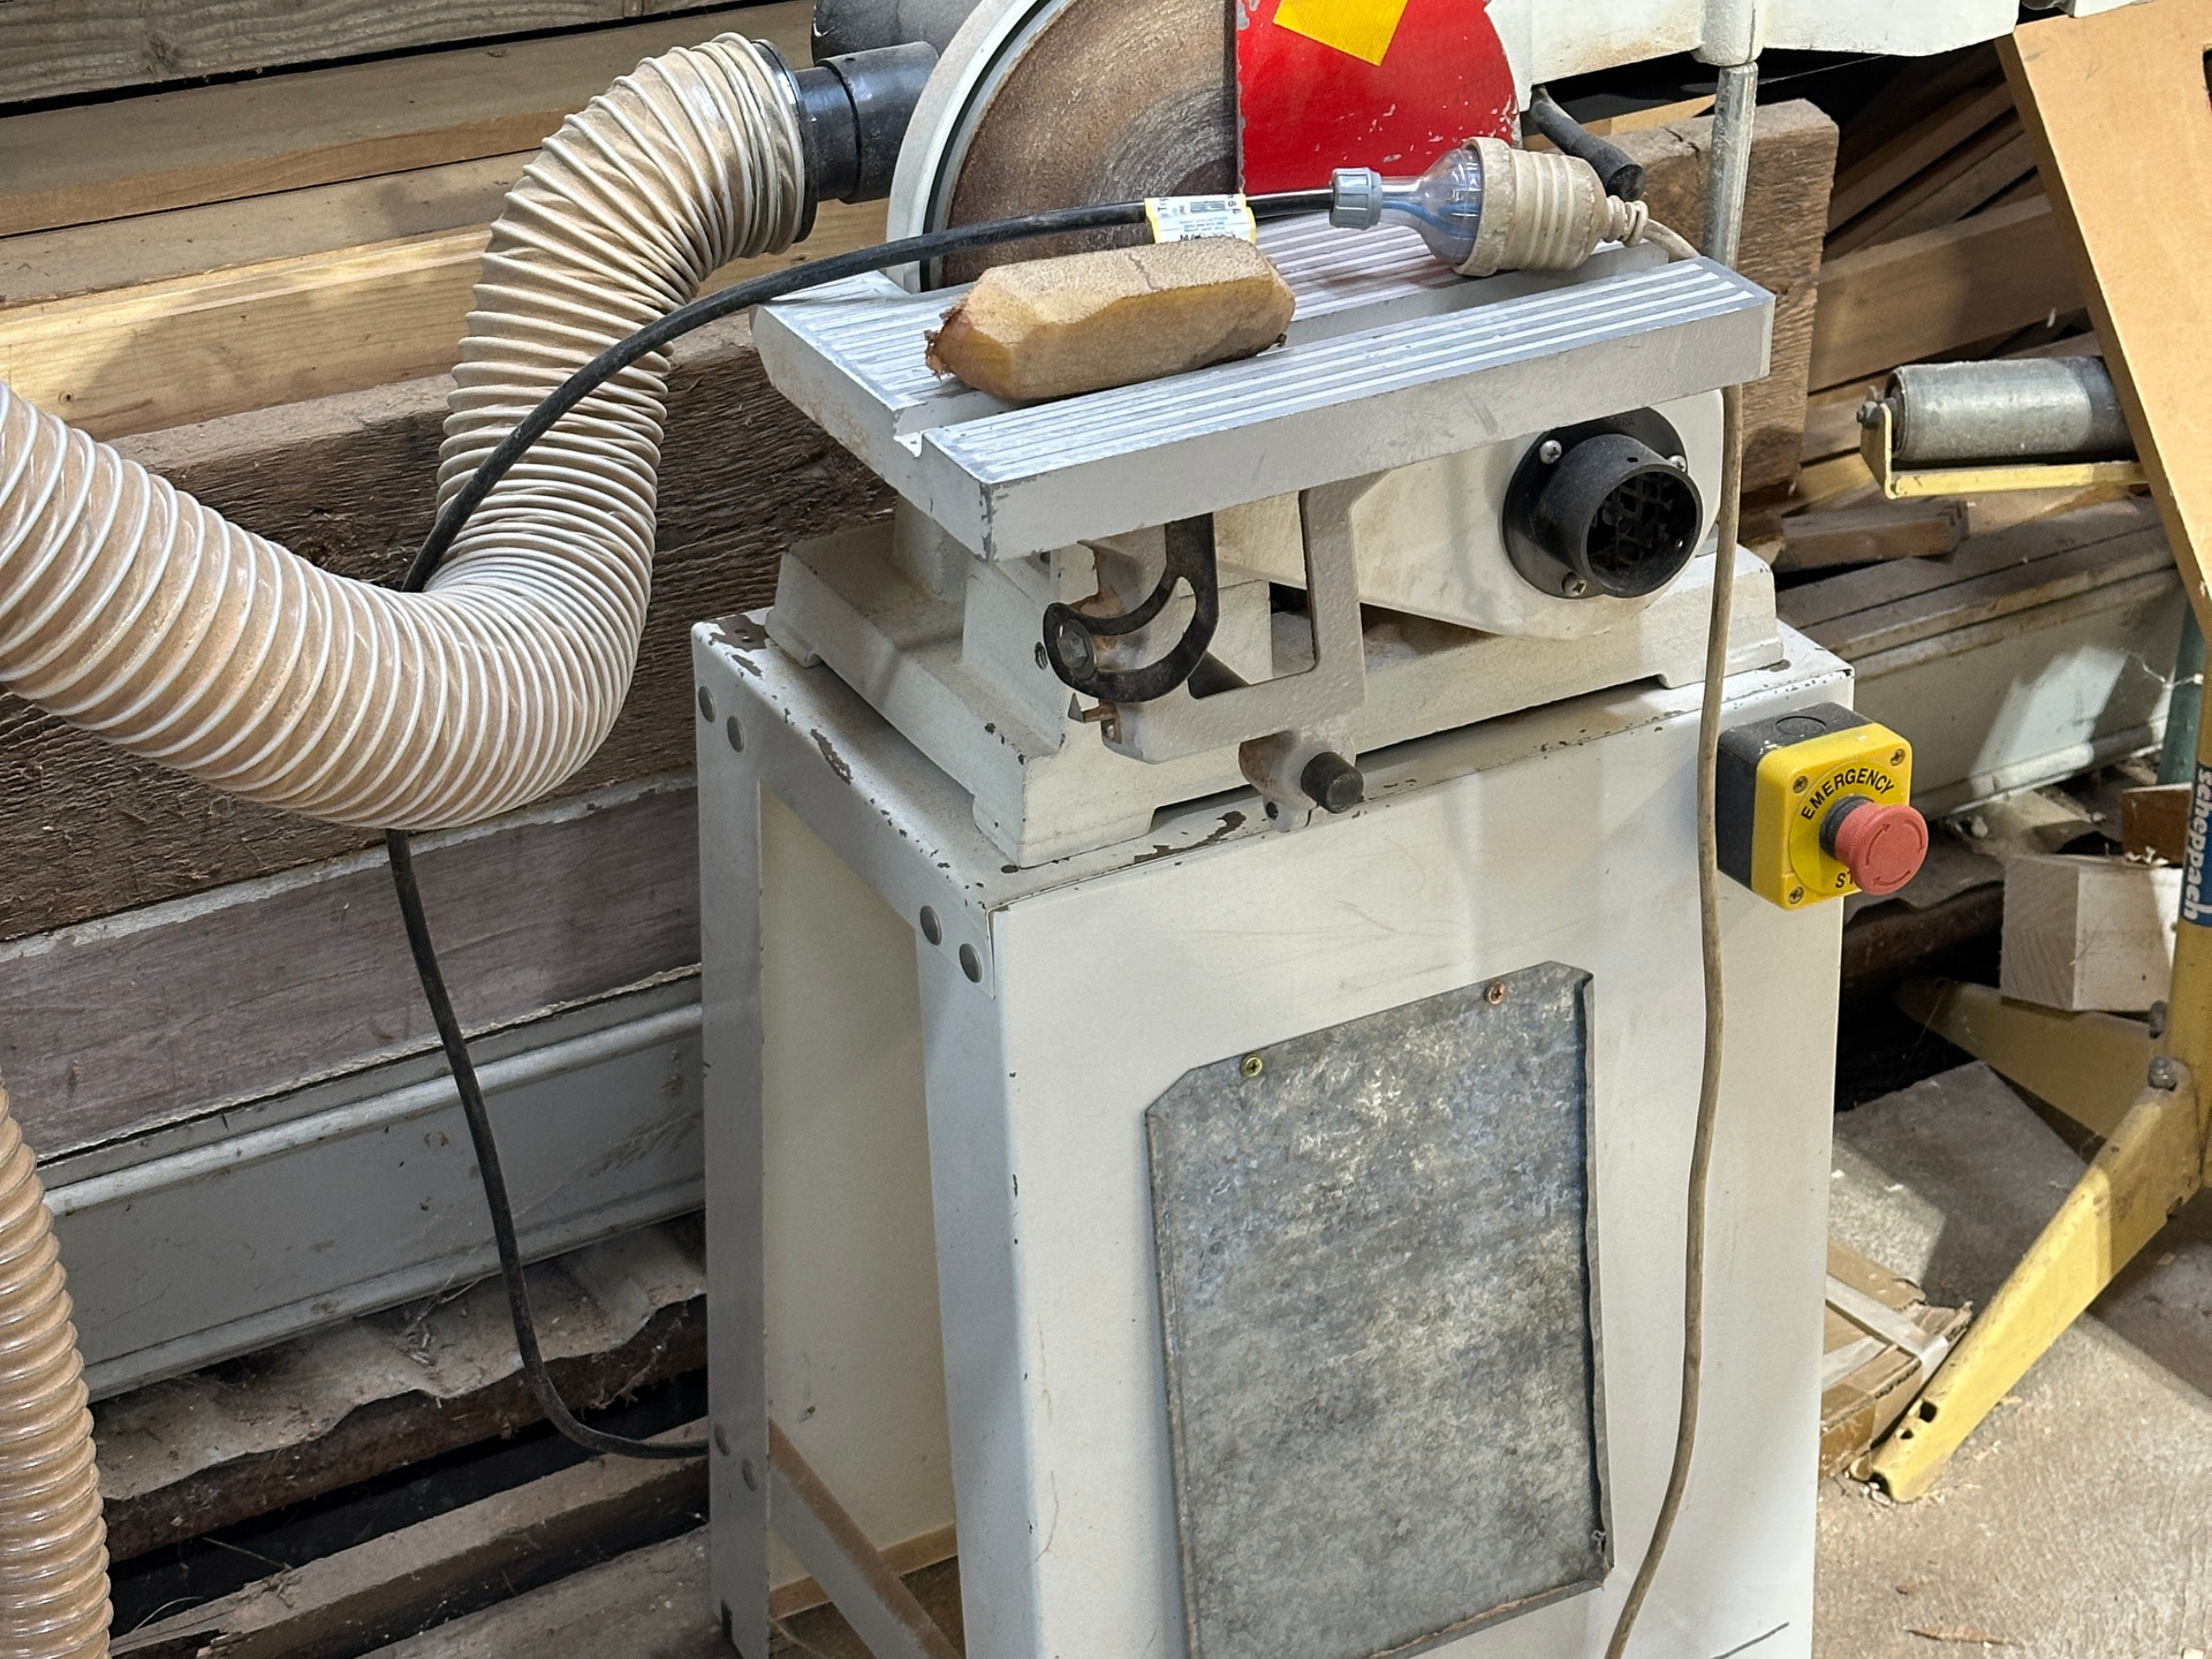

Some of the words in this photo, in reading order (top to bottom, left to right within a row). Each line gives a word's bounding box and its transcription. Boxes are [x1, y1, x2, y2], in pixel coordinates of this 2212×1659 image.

[1802, 768, 1894, 820] EMERGENCY
[2184, 767, 2212, 921] scheppach
[1835, 872, 1856, 889] ST
